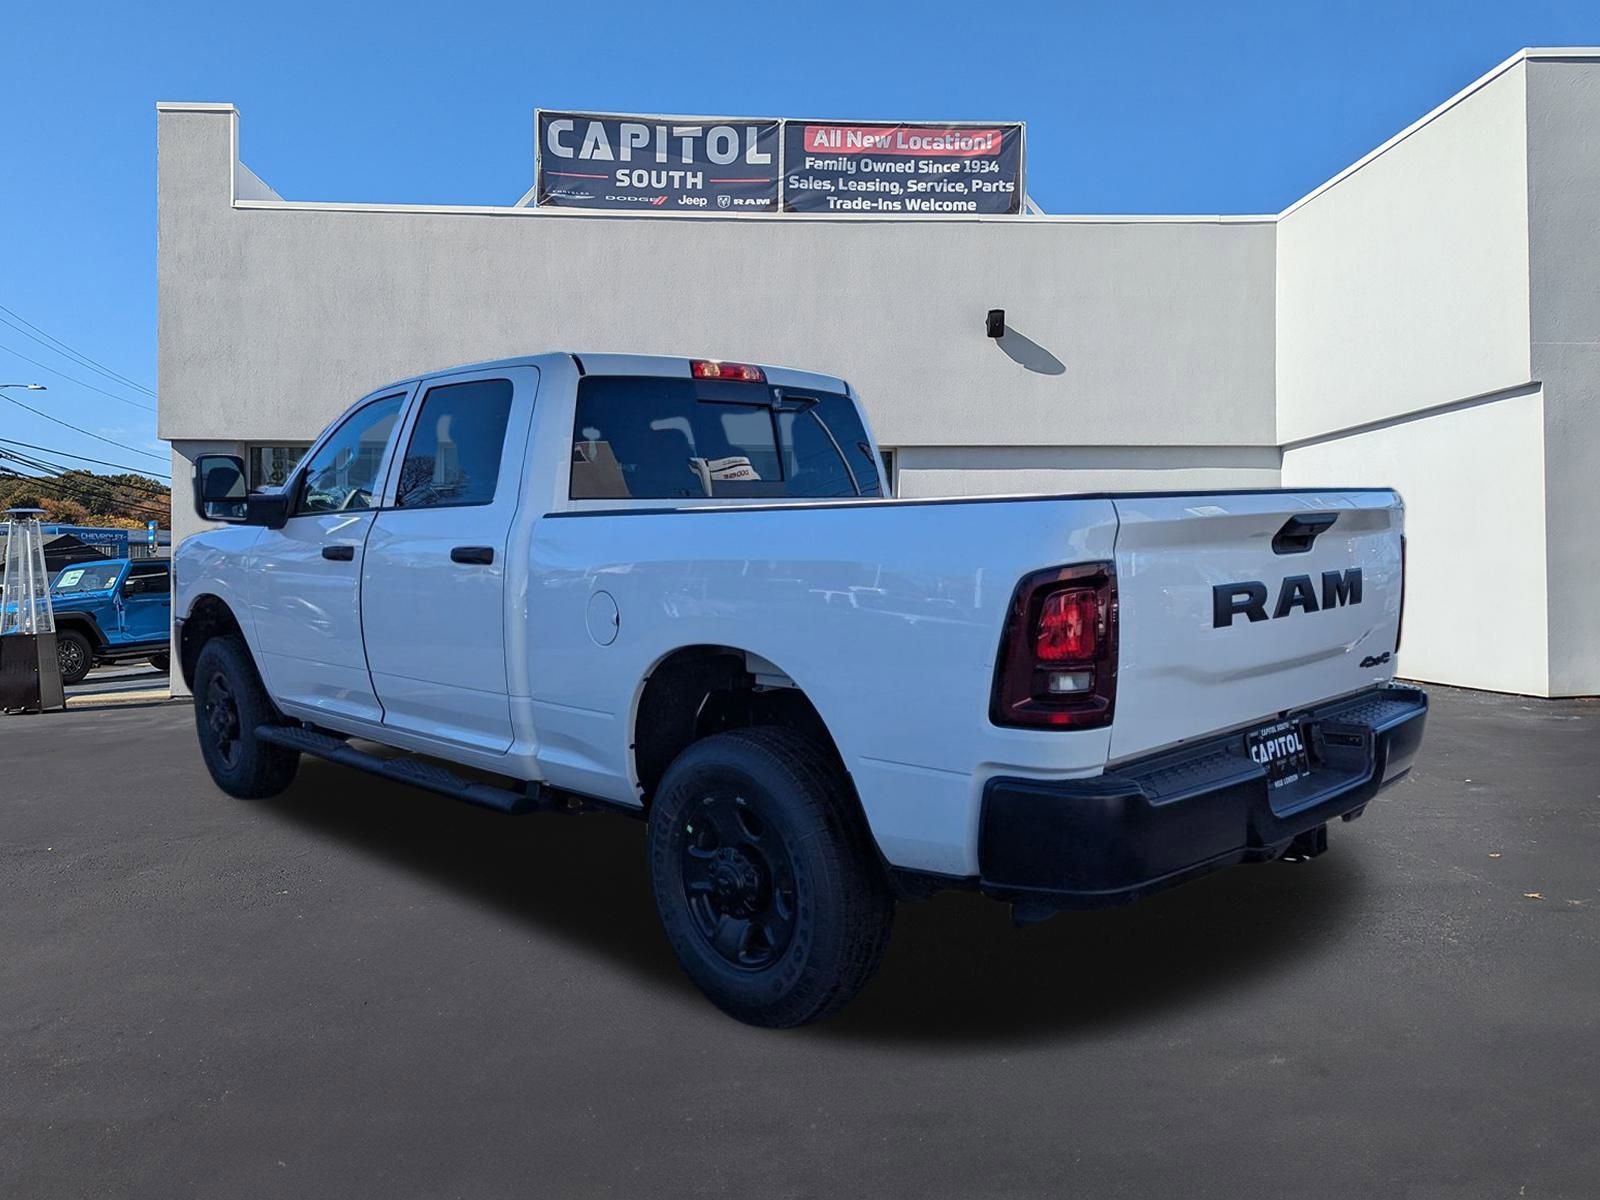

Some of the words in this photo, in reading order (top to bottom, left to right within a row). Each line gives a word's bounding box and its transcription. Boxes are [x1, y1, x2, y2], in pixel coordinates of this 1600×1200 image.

[547, 119, 772, 165] CAPITOL
[813, 129, 842, 147] All
[847, 131, 895, 149] New
[897, 131, 993, 151] Location!
[805, 157, 857, 174] Family
[860, 158, 915, 173] Owned
[918, 159, 961, 174] Since
[963, 160, 1000, 173] 1934
[615, 168, 703, 190] SOUTH
[788, 176, 836, 192] Sales,
[838, 177, 904, 195] Leasing,
[907, 179, 969, 195] Service,
[972, 179, 1015, 193] Parts
[678, 195, 708, 207] Jeep
[733, 198, 771, 206] RAM
[826, 196, 901, 211] Trade-Ins
[905, 198, 978, 212] Welcome
[1213, 567, 1363, 629] RAM
[1251, 732, 1303, 764] CAPITOL
